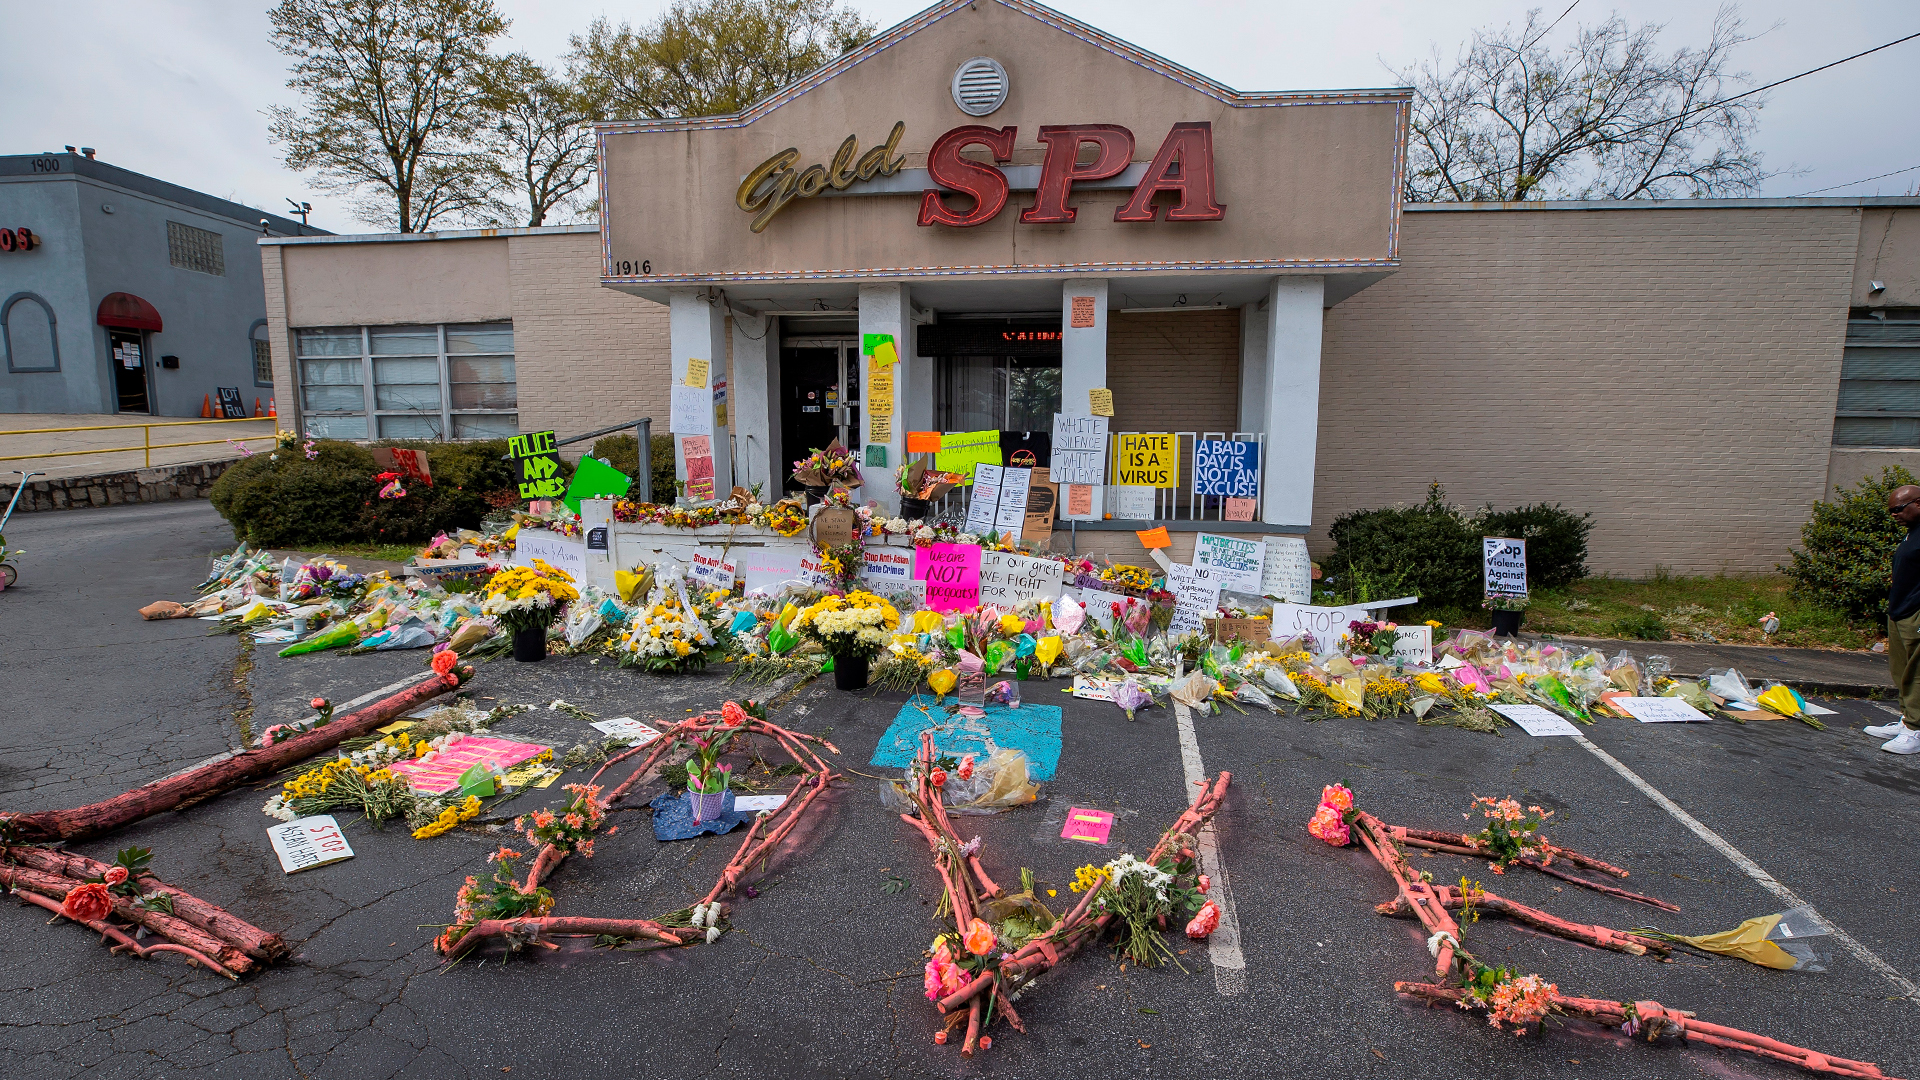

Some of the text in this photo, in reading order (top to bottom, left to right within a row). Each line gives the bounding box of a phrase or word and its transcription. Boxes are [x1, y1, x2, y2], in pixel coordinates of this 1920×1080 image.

[31, 158, 60, 172] 1900
[736, 120, 907, 234] Gold
[917, 121, 1227, 228] SPA
[616, 260, 651, 275] 1916
[221, 389, 238, 401] LOT
[679, 391, 705, 402] ASIAN
[226, 405, 246, 417] FULL
[676, 403, 705, 413] WOMEN
[1057, 417, 1103, 435] WHITE
[508, 430, 558, 459] POLICE
[1059, 435, 1102, 449] SILENCE
[1125, 436, 1169, 451] HATE
[1196, 440, 1247, 456] A BAD
[1052, 447, 1062, 456] IS
[1063, 452, 1097, 469] WHITE
[1129, 452, 1145, 467] IS
[1147, 452, 1161, 467] A
[1196, 453, 1245, 470] DAY IS
[1054, 466, 1104, 484] VIOLENCE
[1119, 469, 1169, 484] VIRUS
[1195, 466, 1258, 483] NOT AN
[1194, 480, 1257, 497] EXCUSE
[520, 541, 548, 556] Black
[693, 553, 707, 565] Stop
[800, 558, 814, 572] Stop
[863, 551, 910, 565] Stop Anti-Asian
[983, 552, 1061, 579] In our grief,
[1486, 557, 1525, 569] Violence
[694, 564, 709, 576] Hate
[867, 563, 905, 576] Hate Crimes
[925, 564, 967, 583] NOT
[1173, 563, 1191, 575] SAY
[1194, 568, 1210, 579] NO
[1212, 572, 1223, 583] TO
[1487, 568, 1525, 581] Against
[870, 581, 882, 589] WE
[1007, 573, 1047, 590] FIGHT
[1169, 573, 1197, 585] WHITE
[1487, 579, 1525, 591] Women!
[926, 586, 978, 603] apegoats!
[981, 585, 1034, 602] FOR YOU
[1178, 600, 1209, 611] merica!
[1173, 615, 1200, 626] i-Asian
[1292, 608, 1346, 634] STOP
[309, 825, 345, 852] STOP
